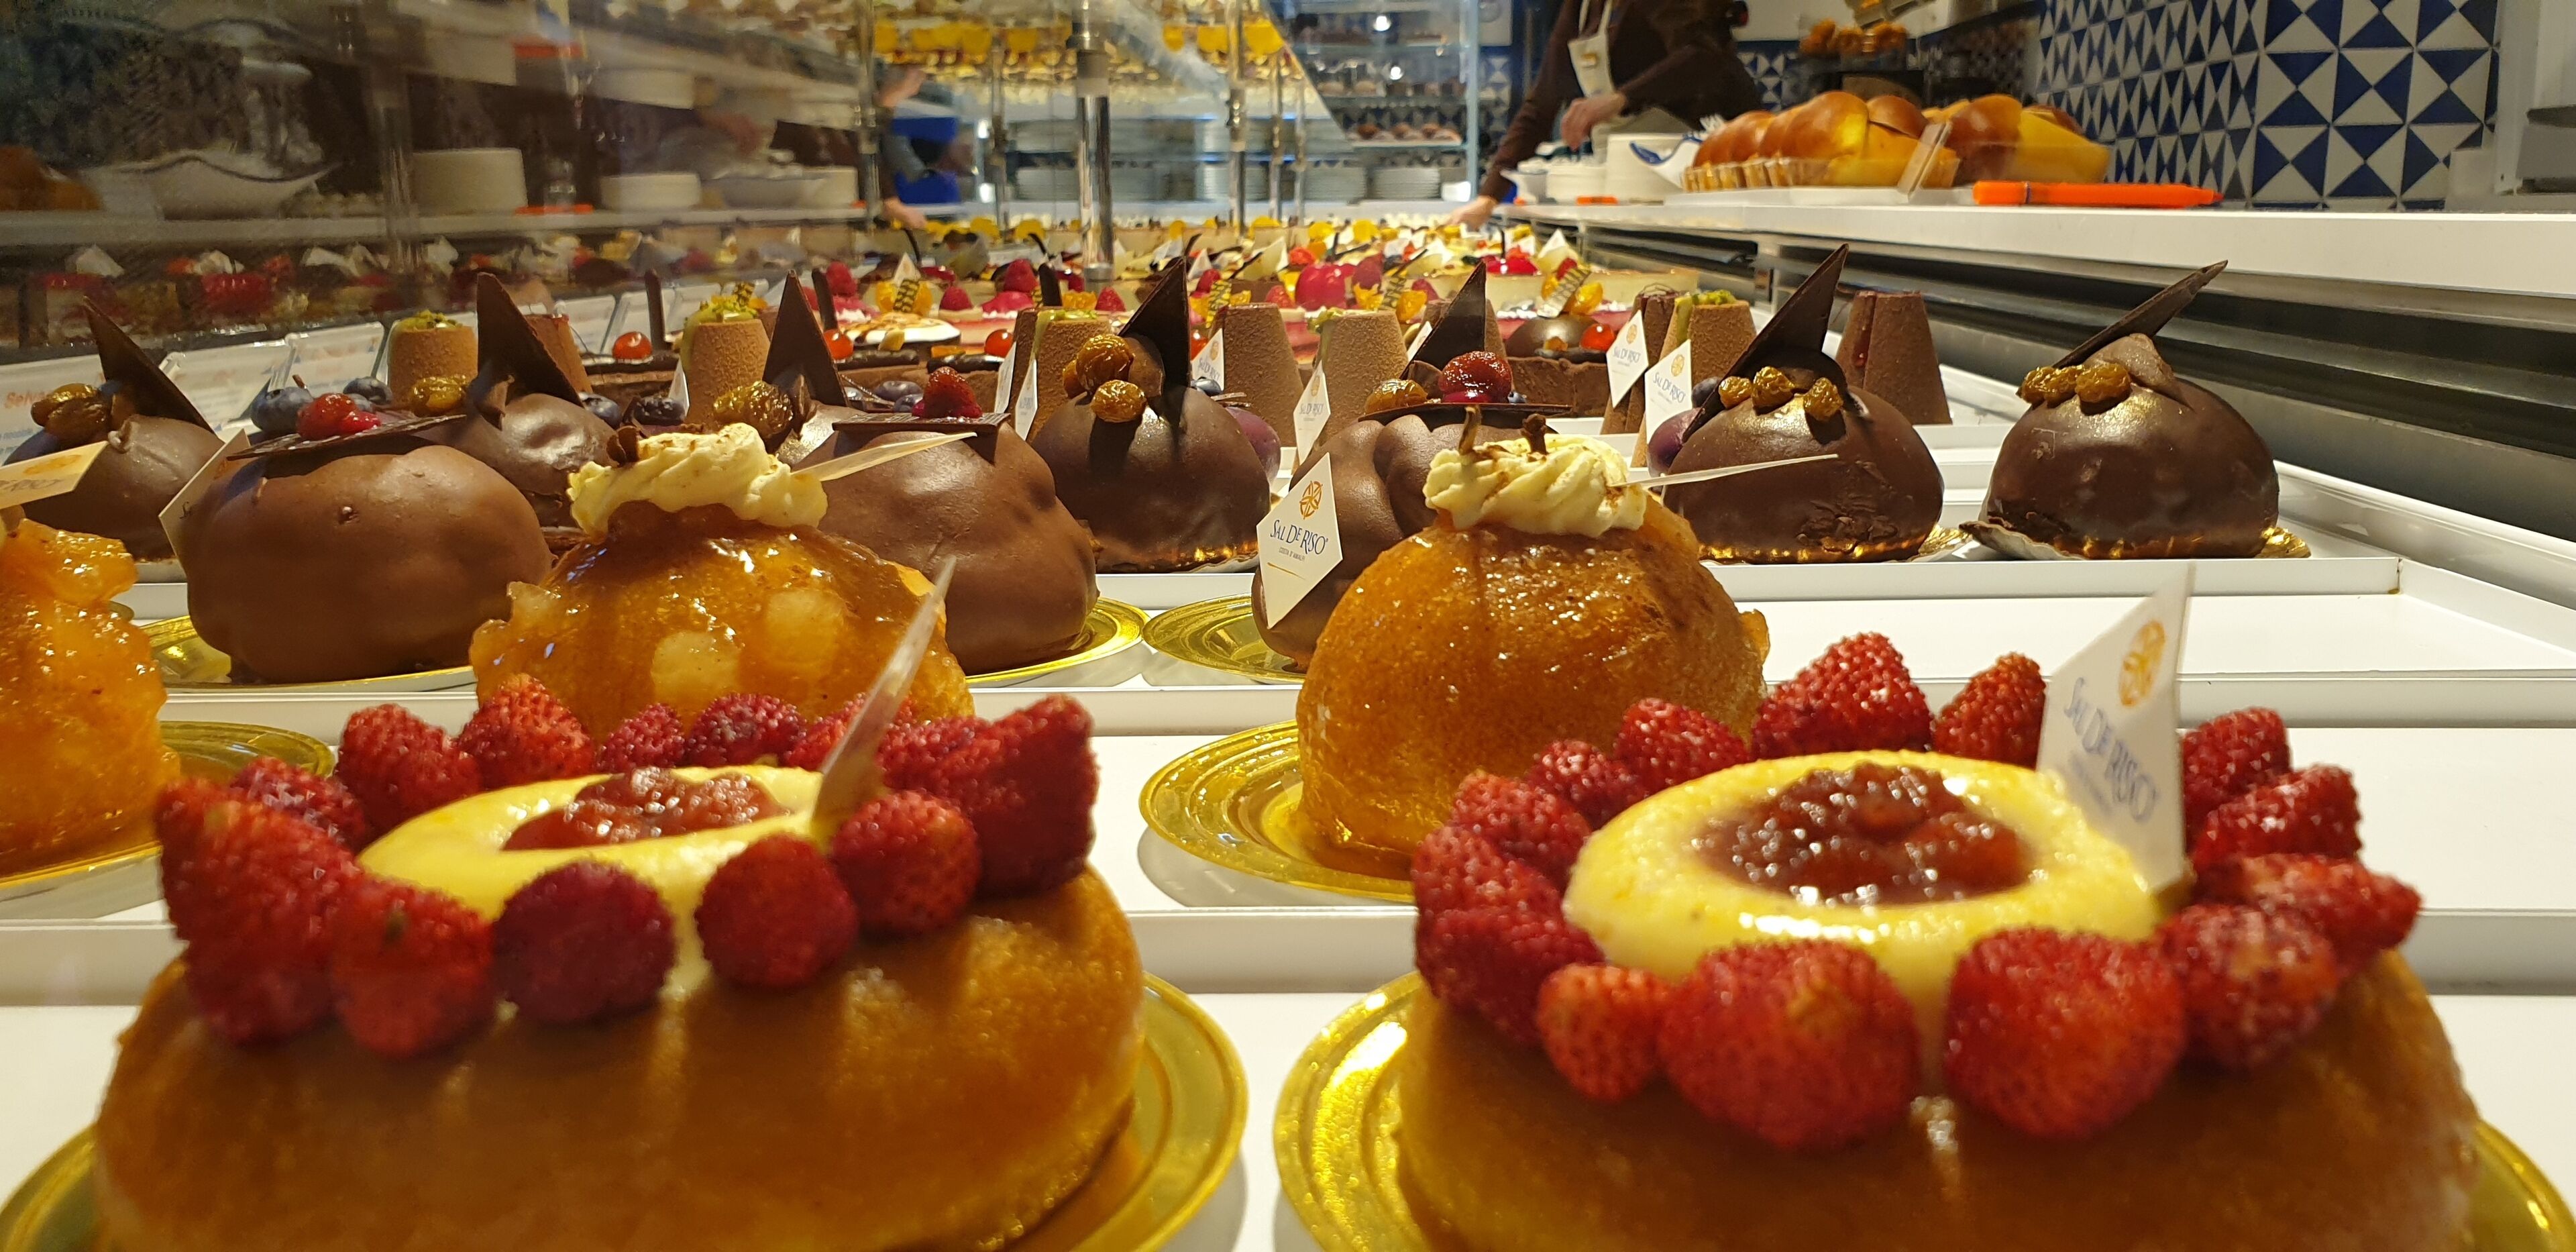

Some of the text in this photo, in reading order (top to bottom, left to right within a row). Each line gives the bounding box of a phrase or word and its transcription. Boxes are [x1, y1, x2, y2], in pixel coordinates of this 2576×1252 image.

[1669, 384, 1686, 403] RISO
[1270, 519, 1326, 555] SAL DE RISO
[2081, 707, 2114, 756] DE
[2104, 737, 2159, 824] RISO
